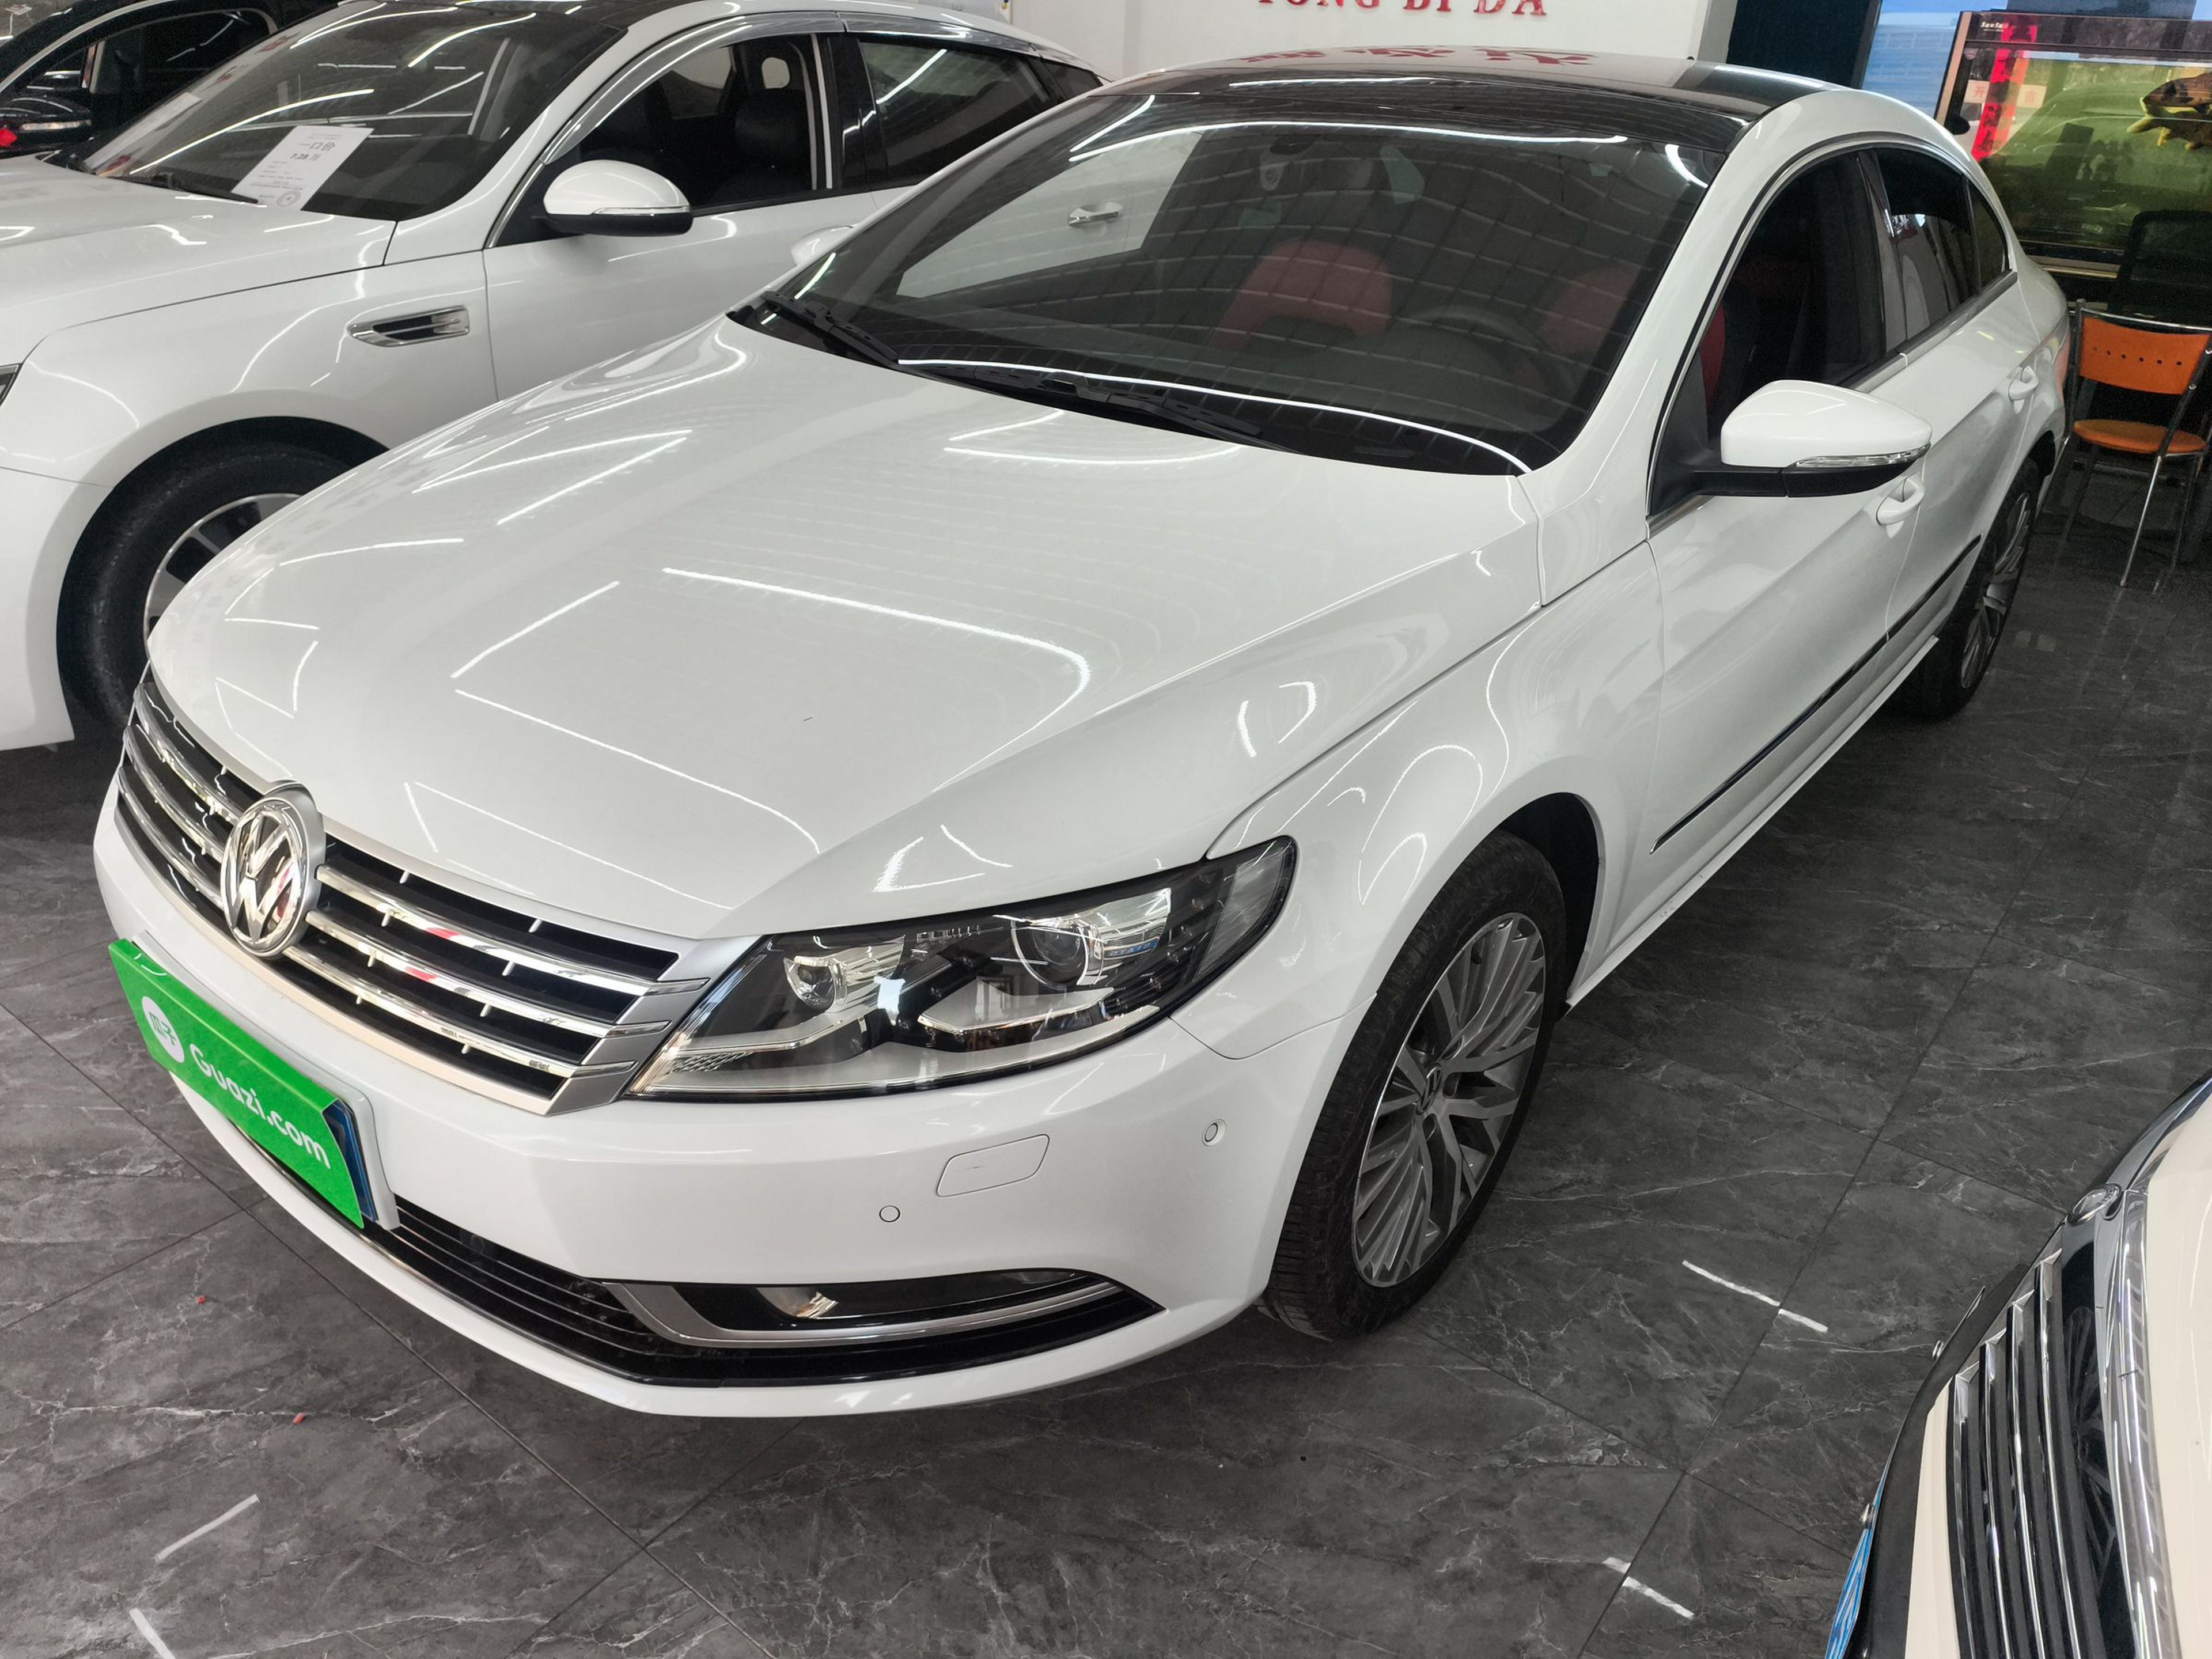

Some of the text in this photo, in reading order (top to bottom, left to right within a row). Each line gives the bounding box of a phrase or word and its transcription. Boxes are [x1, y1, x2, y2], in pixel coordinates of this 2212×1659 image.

[298, 142, 335, 151] 一口价
[190, 1044, 331, 1169] Guazi.com
